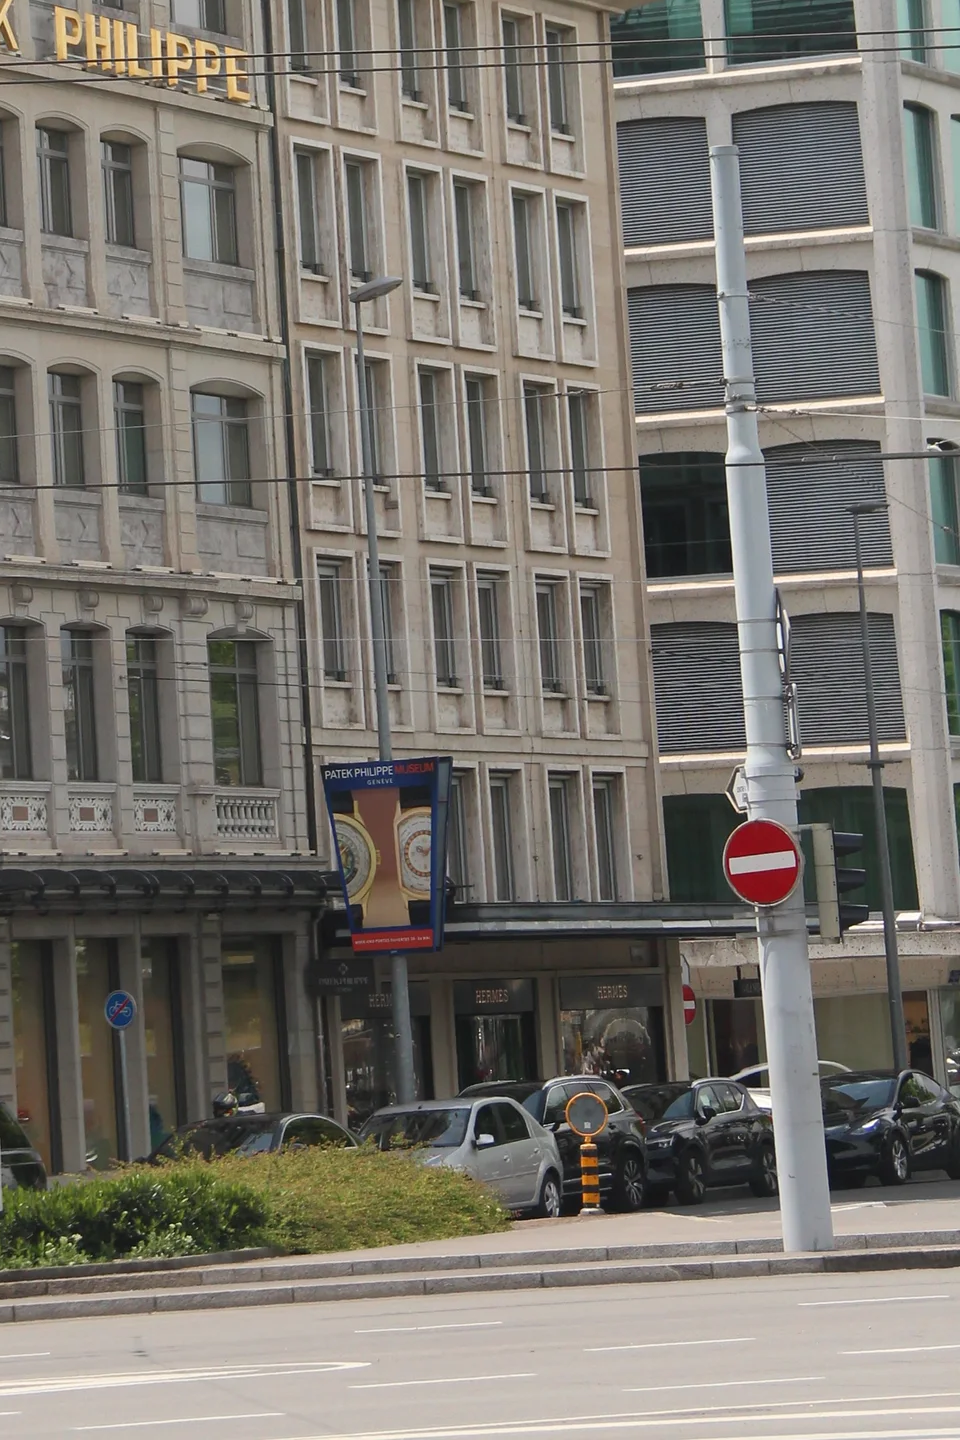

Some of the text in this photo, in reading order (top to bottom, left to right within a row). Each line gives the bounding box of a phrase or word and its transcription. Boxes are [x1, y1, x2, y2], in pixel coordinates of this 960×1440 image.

[54, 5, 251, 103] PHILIPPE
[324, 762, 434, 780] PATEK PHILIPPE MUSEUM
